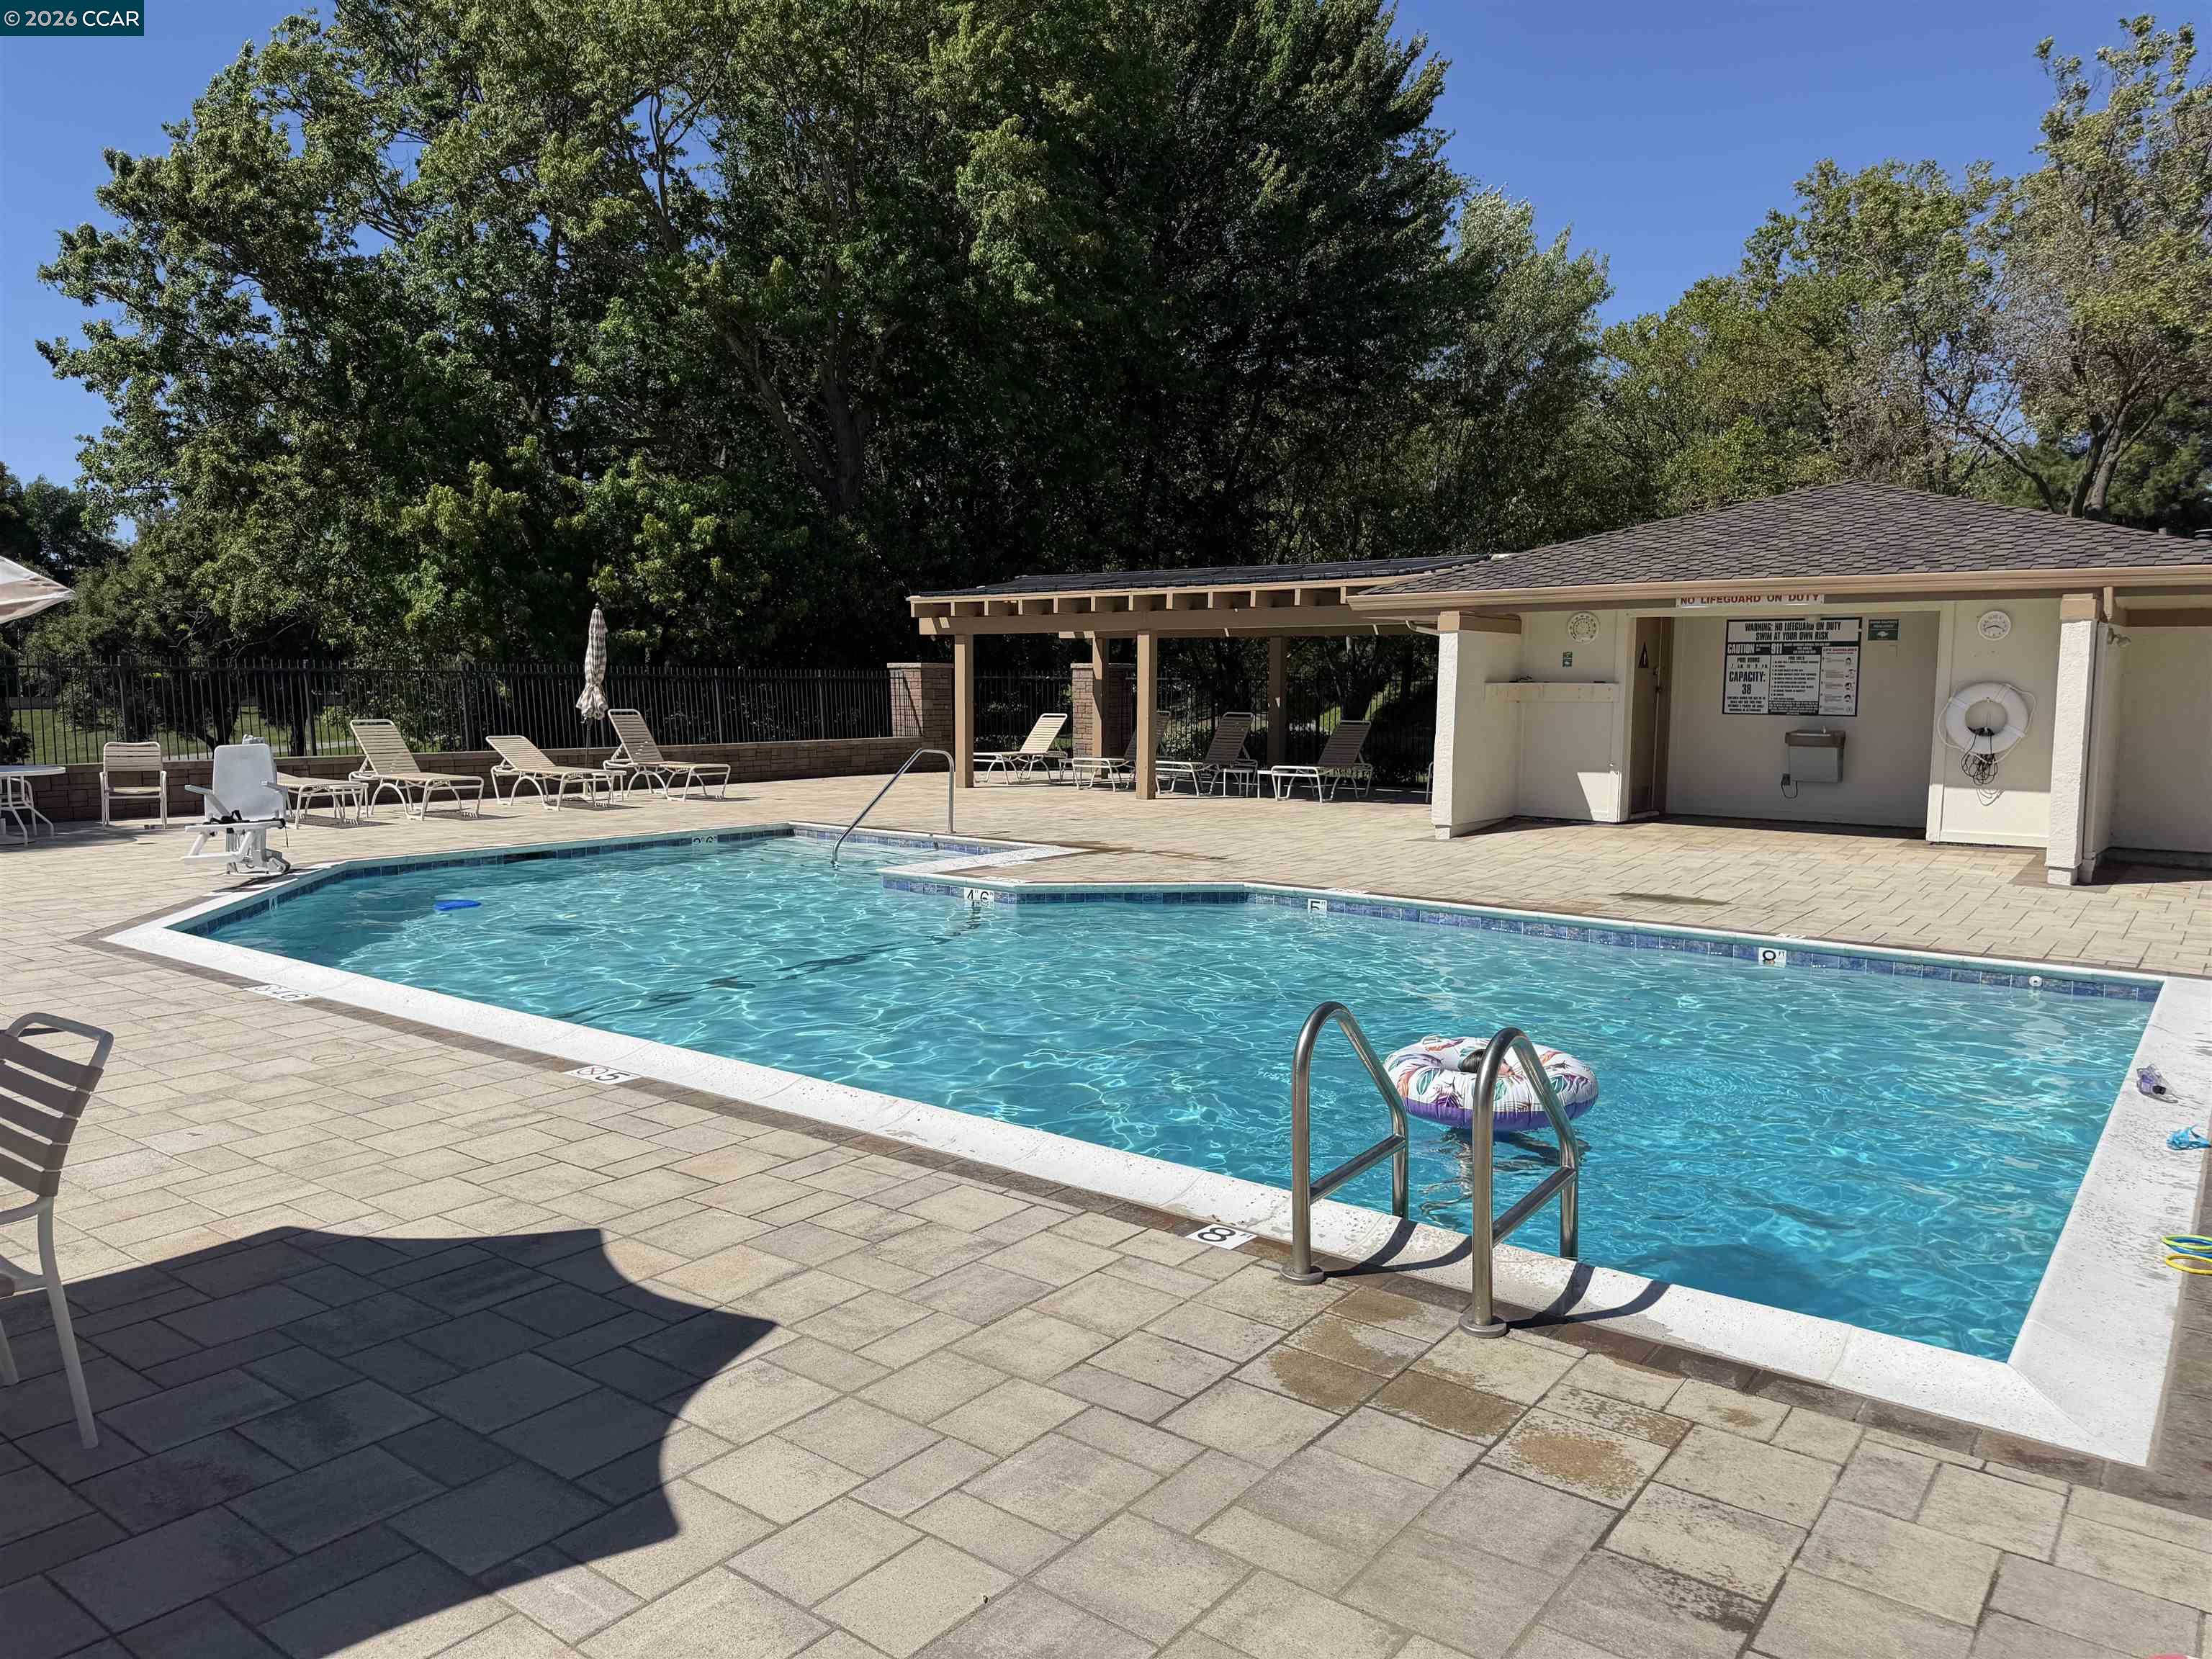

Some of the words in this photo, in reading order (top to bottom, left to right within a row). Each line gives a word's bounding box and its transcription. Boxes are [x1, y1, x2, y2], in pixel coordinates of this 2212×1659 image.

[1701, 595, 1761, 604] LIFEGUARD
[1745, 623, 1773, 631] WARNING:
[1775, 622, 1783, 631] NO
[1784, 621, 1815, 631] LIFEGUARD
[1816, 621, 1825, 631] ON
[1826, 621, 1841, 630] DUTY
[1755, 632, 1772, 641] SWIM
[1782, 631, 1798, 640] YOUR
[1799, 631, 1813, 640] OWN
[1815, 631, 1829, 640] RISK
[1727, 644, 1755, 654] CAUTION
[1771, 643, 1783, 654] 911
[1729, 671, 1766, 683] CAPACITY:
[1742, 684, 1752, 695] 38
[1197, 1227, 1236, 1242] 8
